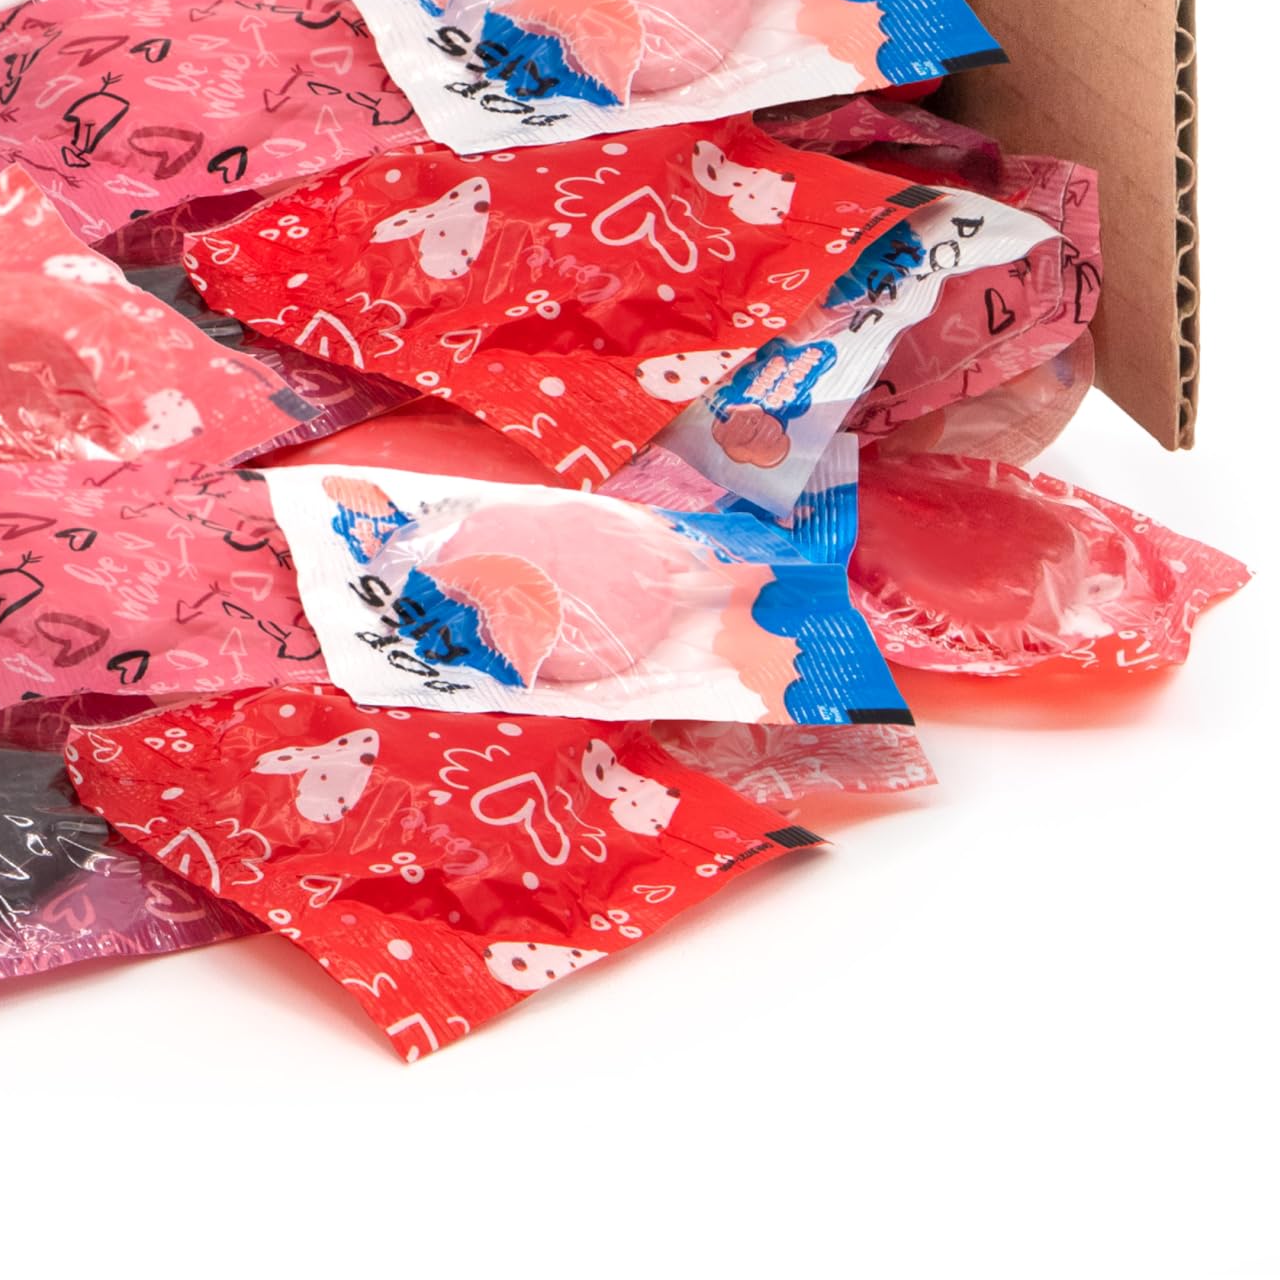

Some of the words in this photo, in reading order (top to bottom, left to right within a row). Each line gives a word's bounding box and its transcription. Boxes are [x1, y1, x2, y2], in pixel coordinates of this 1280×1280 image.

[427, 26, 560, 97] KISS
[444, 80, 571, 127] POP
[916, 216, 985, 282] PO
[348, 574, 470, 662] KISS
[355, 631, 473, 694] POP
